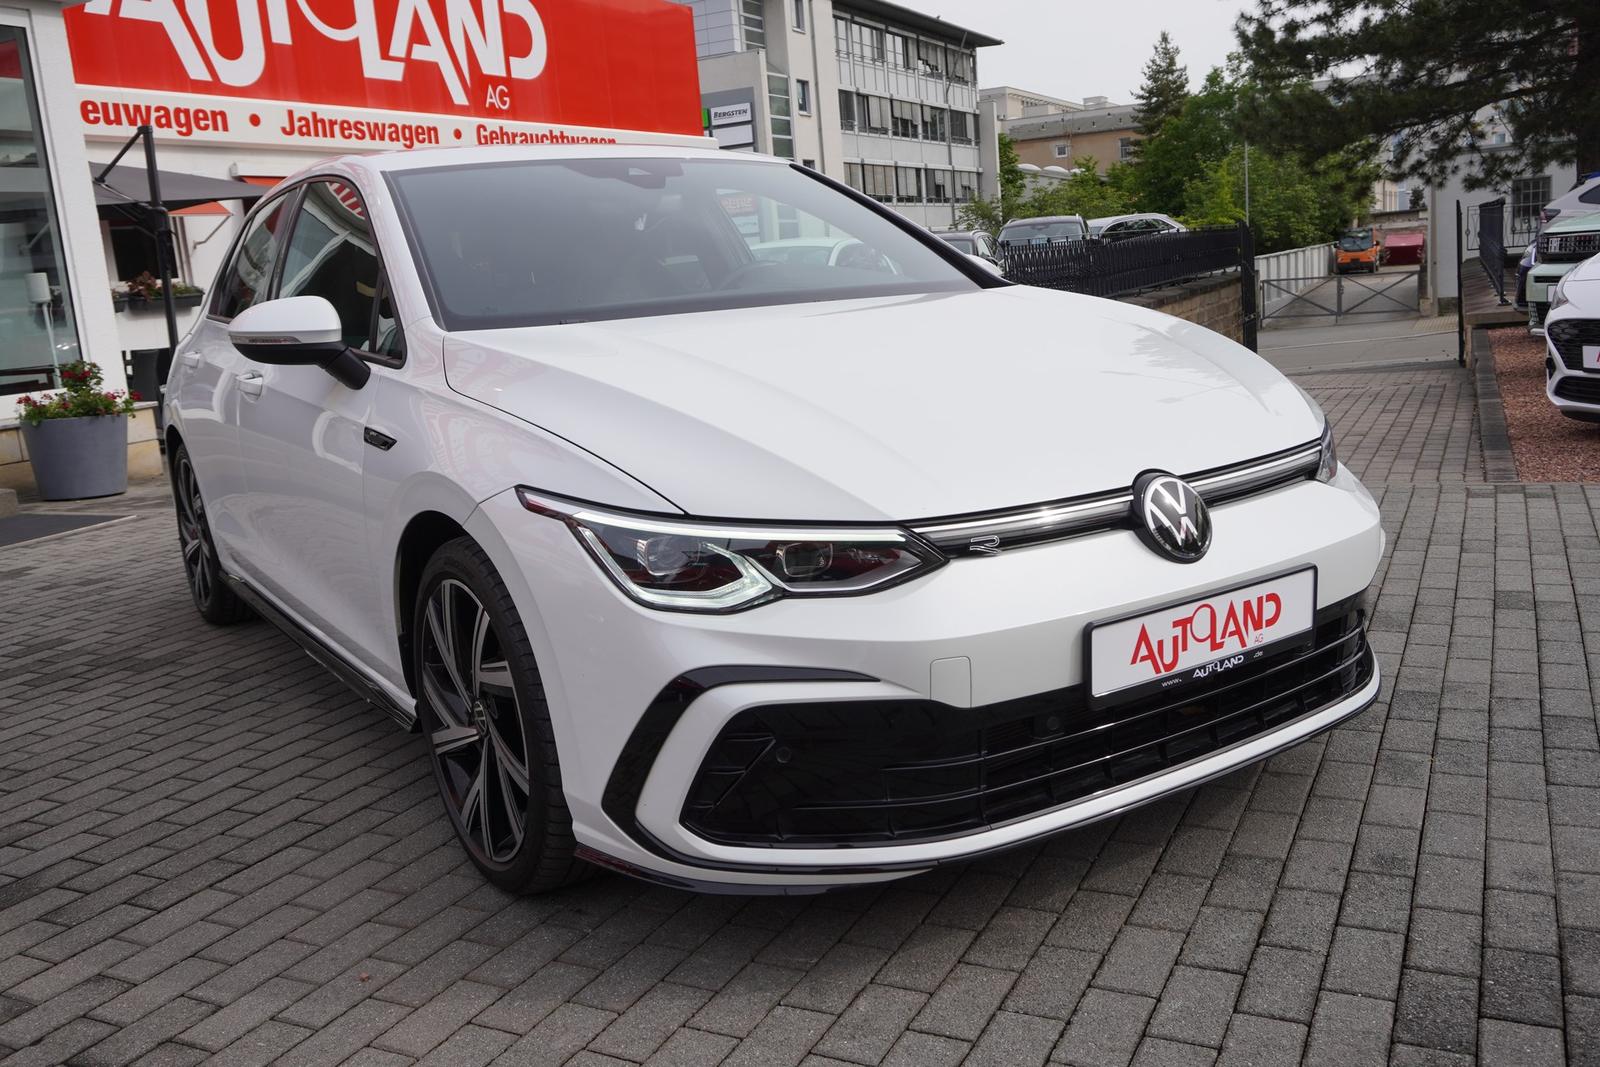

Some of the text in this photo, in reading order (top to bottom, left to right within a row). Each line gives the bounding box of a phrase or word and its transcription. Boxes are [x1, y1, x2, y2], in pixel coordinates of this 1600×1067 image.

[485, 85, 509, 109] AG
[80, 99, 229, 137] euwagen
[280, 109, 439, 149] Jahreswagen
[1130, 593, 1282, 674] AUTOLAND
[1253, 633, 1264, 644] AG
[1192, 655, 1244, 679] AUTOLAND
